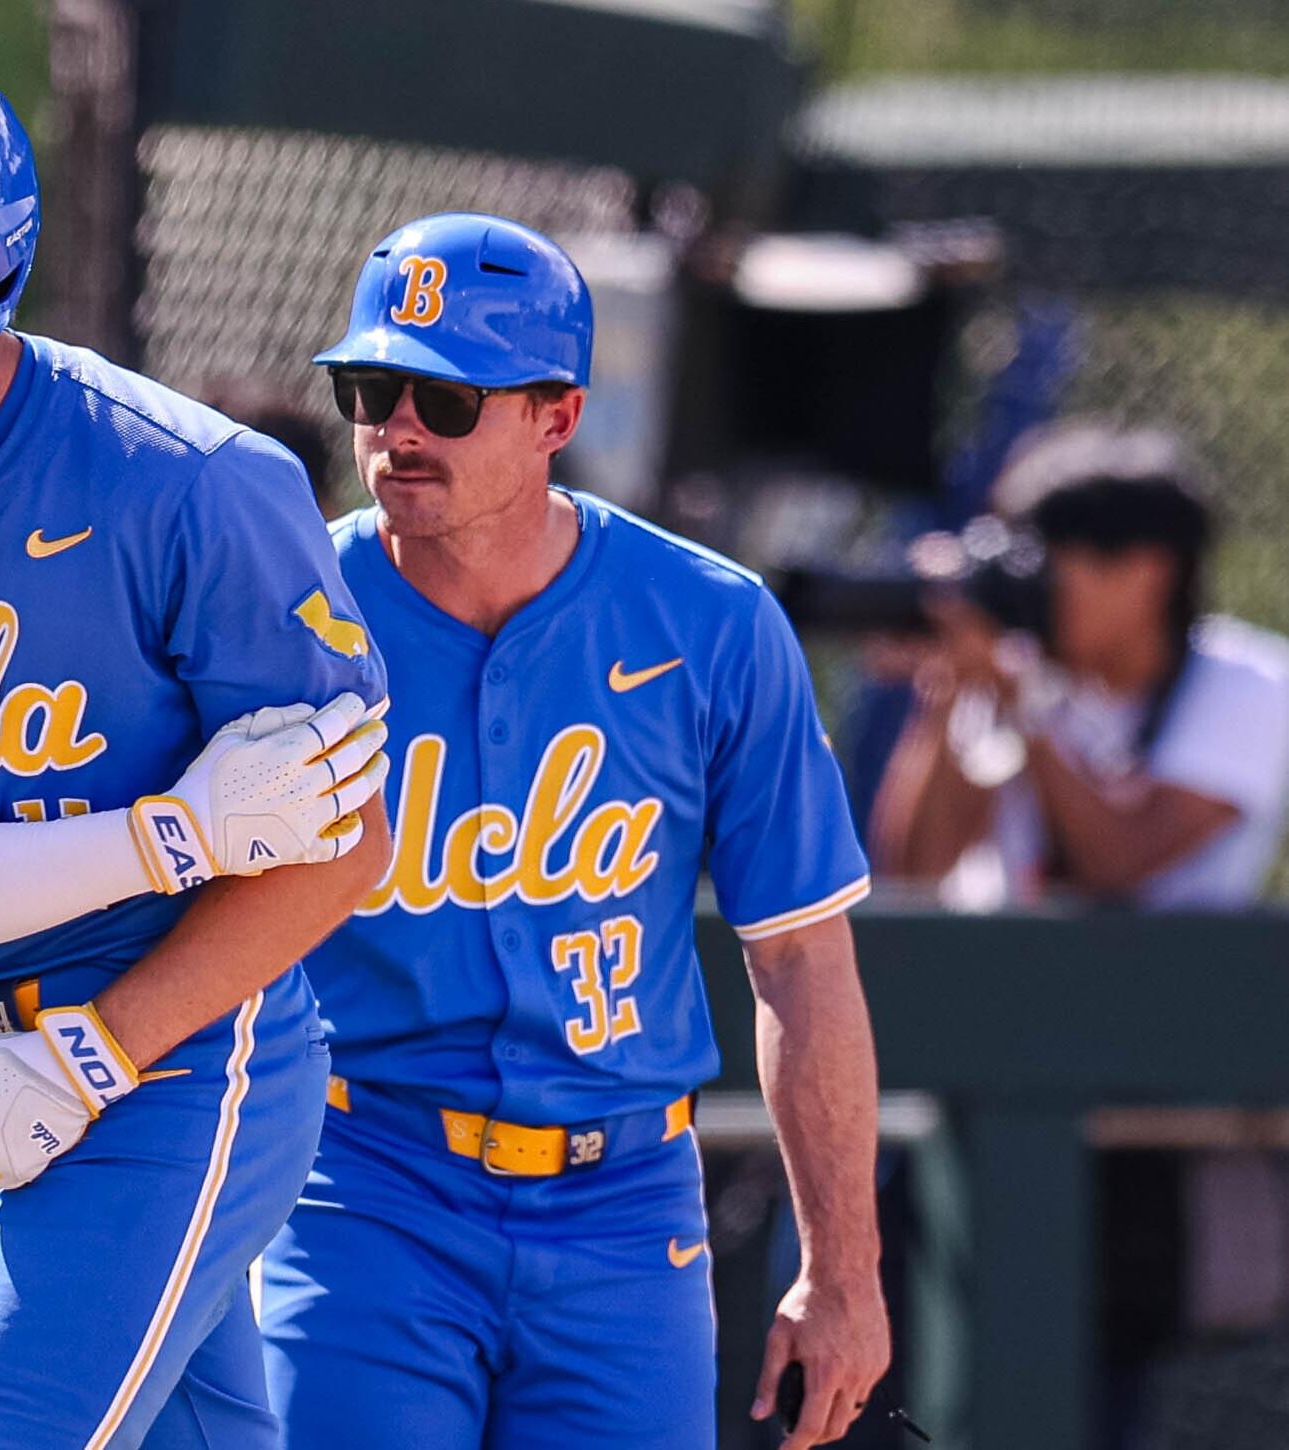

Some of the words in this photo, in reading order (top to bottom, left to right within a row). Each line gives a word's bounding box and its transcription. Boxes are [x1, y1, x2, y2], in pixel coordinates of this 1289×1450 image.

[390, 254, 447, 327] B
[551, 915, 644, 1056] 32
[569, 1130, 605, 1165] 32
